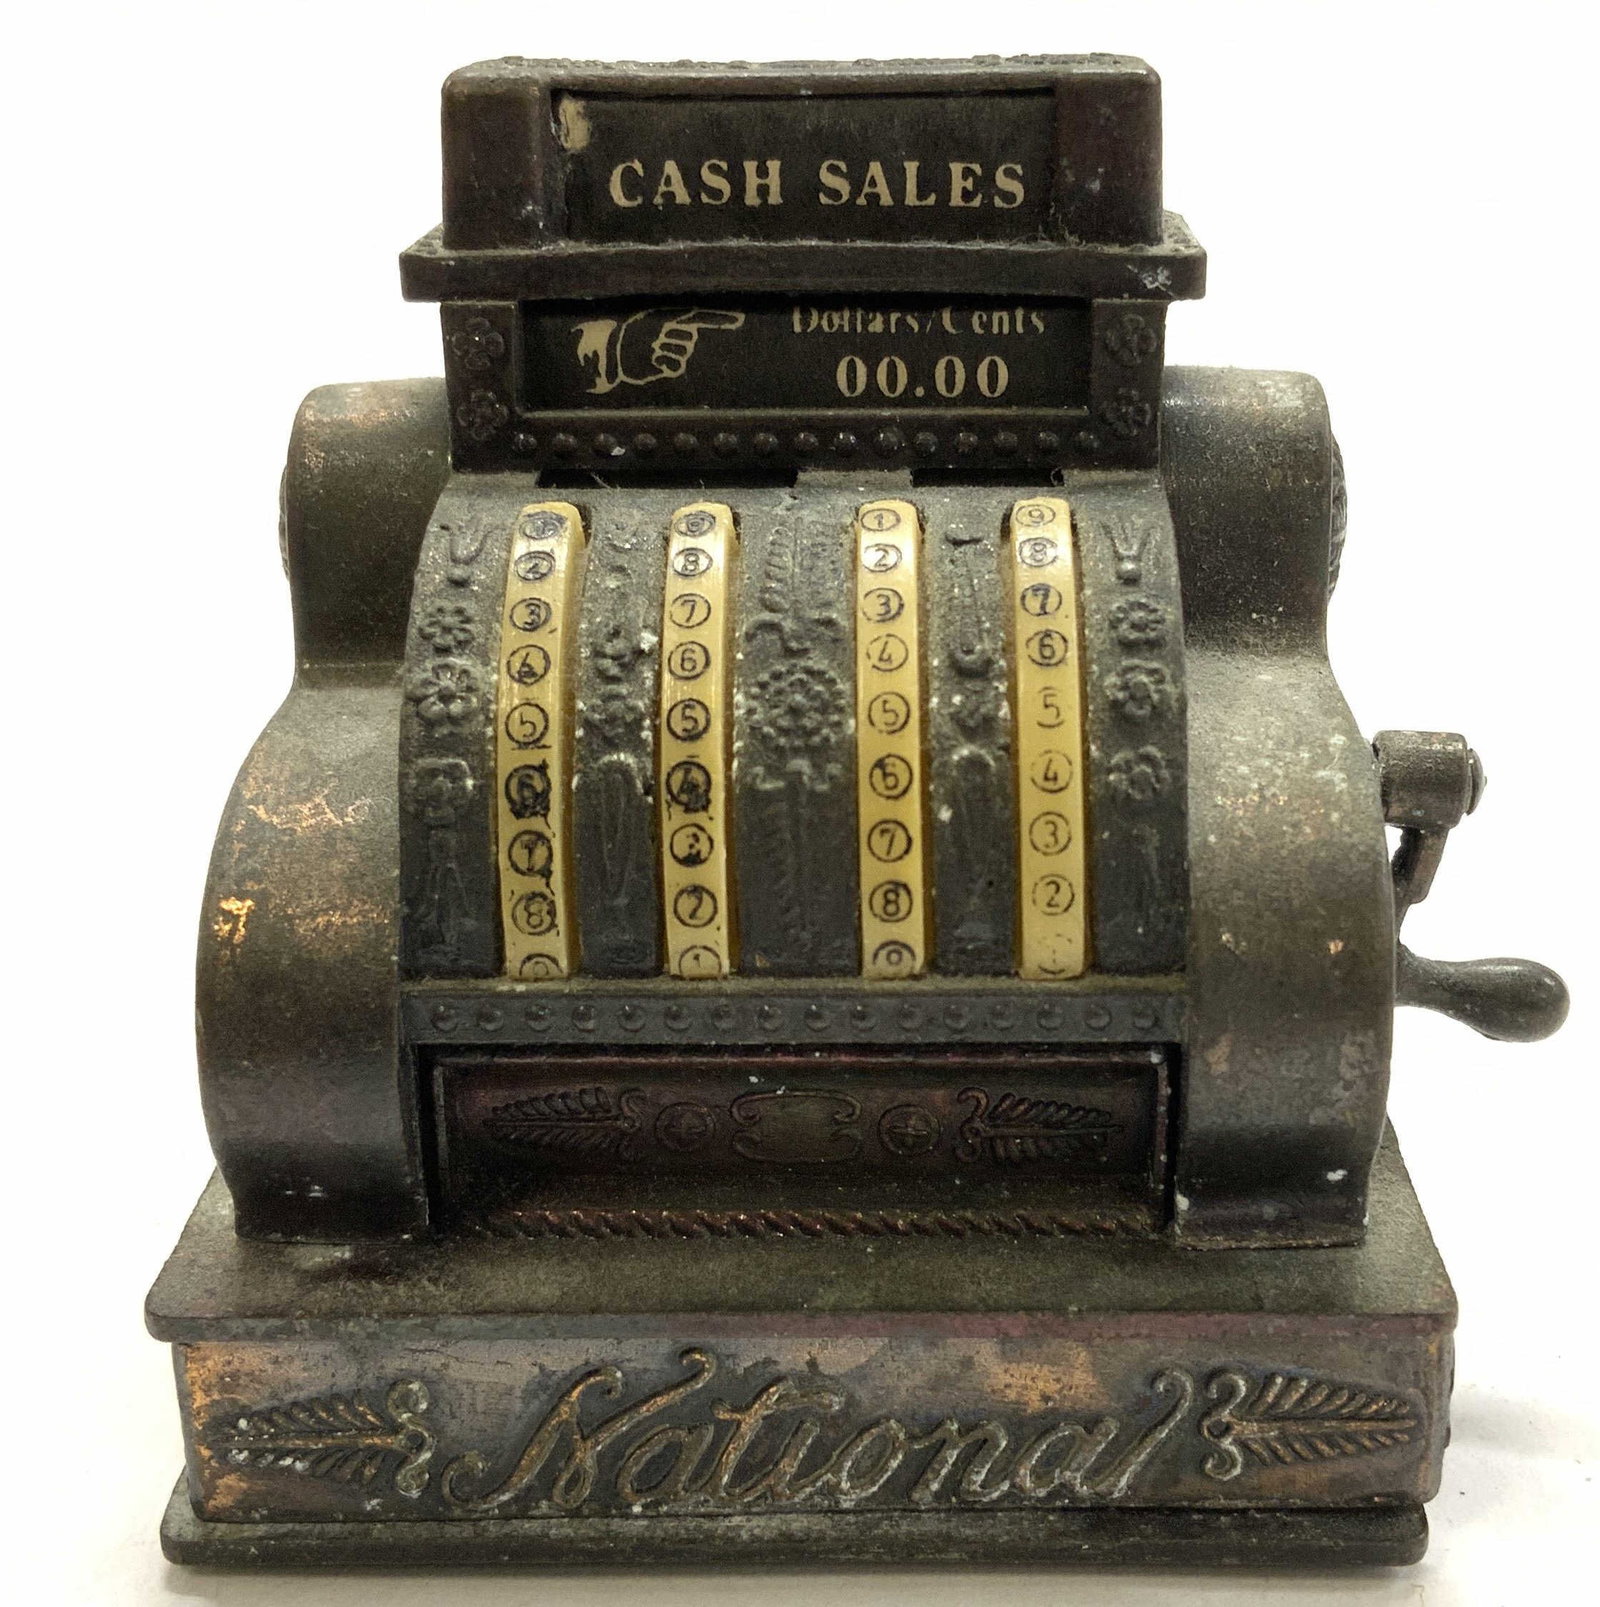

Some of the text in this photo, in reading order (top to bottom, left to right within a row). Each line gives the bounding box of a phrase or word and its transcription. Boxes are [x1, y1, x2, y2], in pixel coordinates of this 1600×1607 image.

[608, 157, 1026, 211] CASH SALES
[836, 355, 1010, 399] 00.00
[441, 1346, 1195, 1509] National
